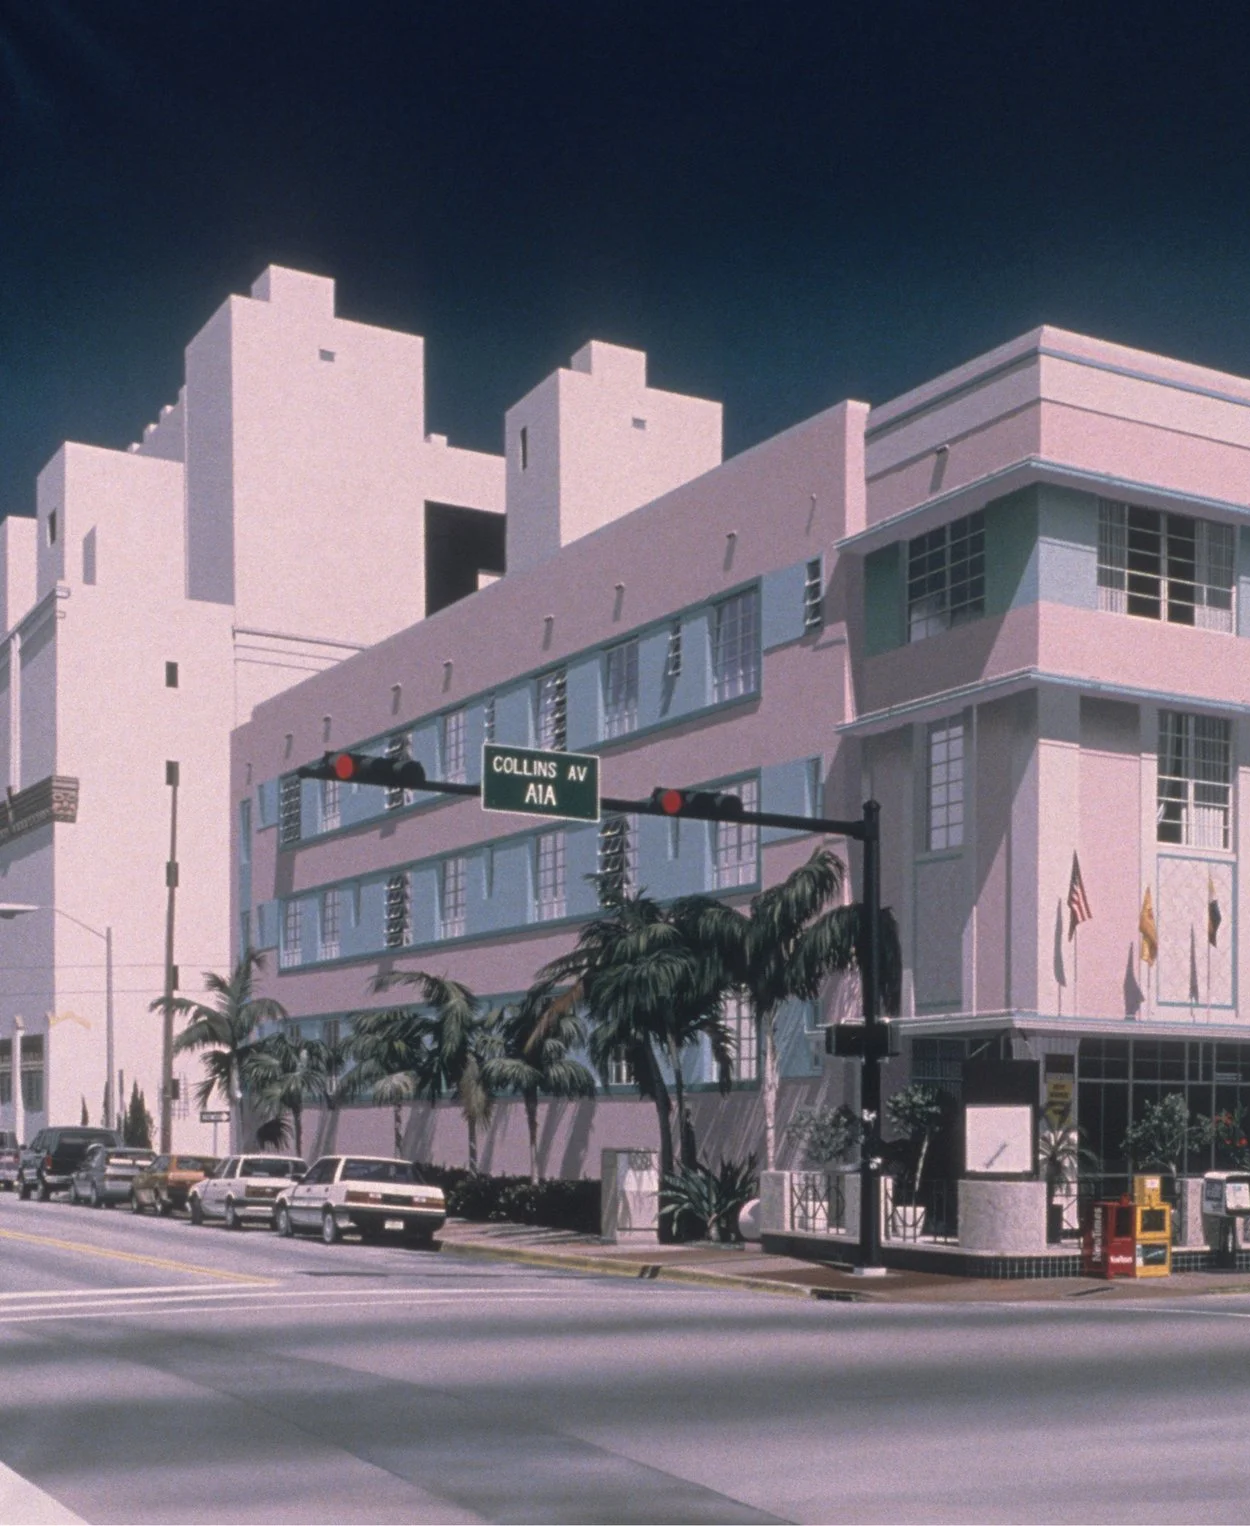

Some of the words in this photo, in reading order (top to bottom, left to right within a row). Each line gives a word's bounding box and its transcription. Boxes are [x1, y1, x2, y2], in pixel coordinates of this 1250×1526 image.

[492, 755, 558, 778] COLLINS
[567, 764, 588, 782] AV
[524, 782, 557, 806] A1A
